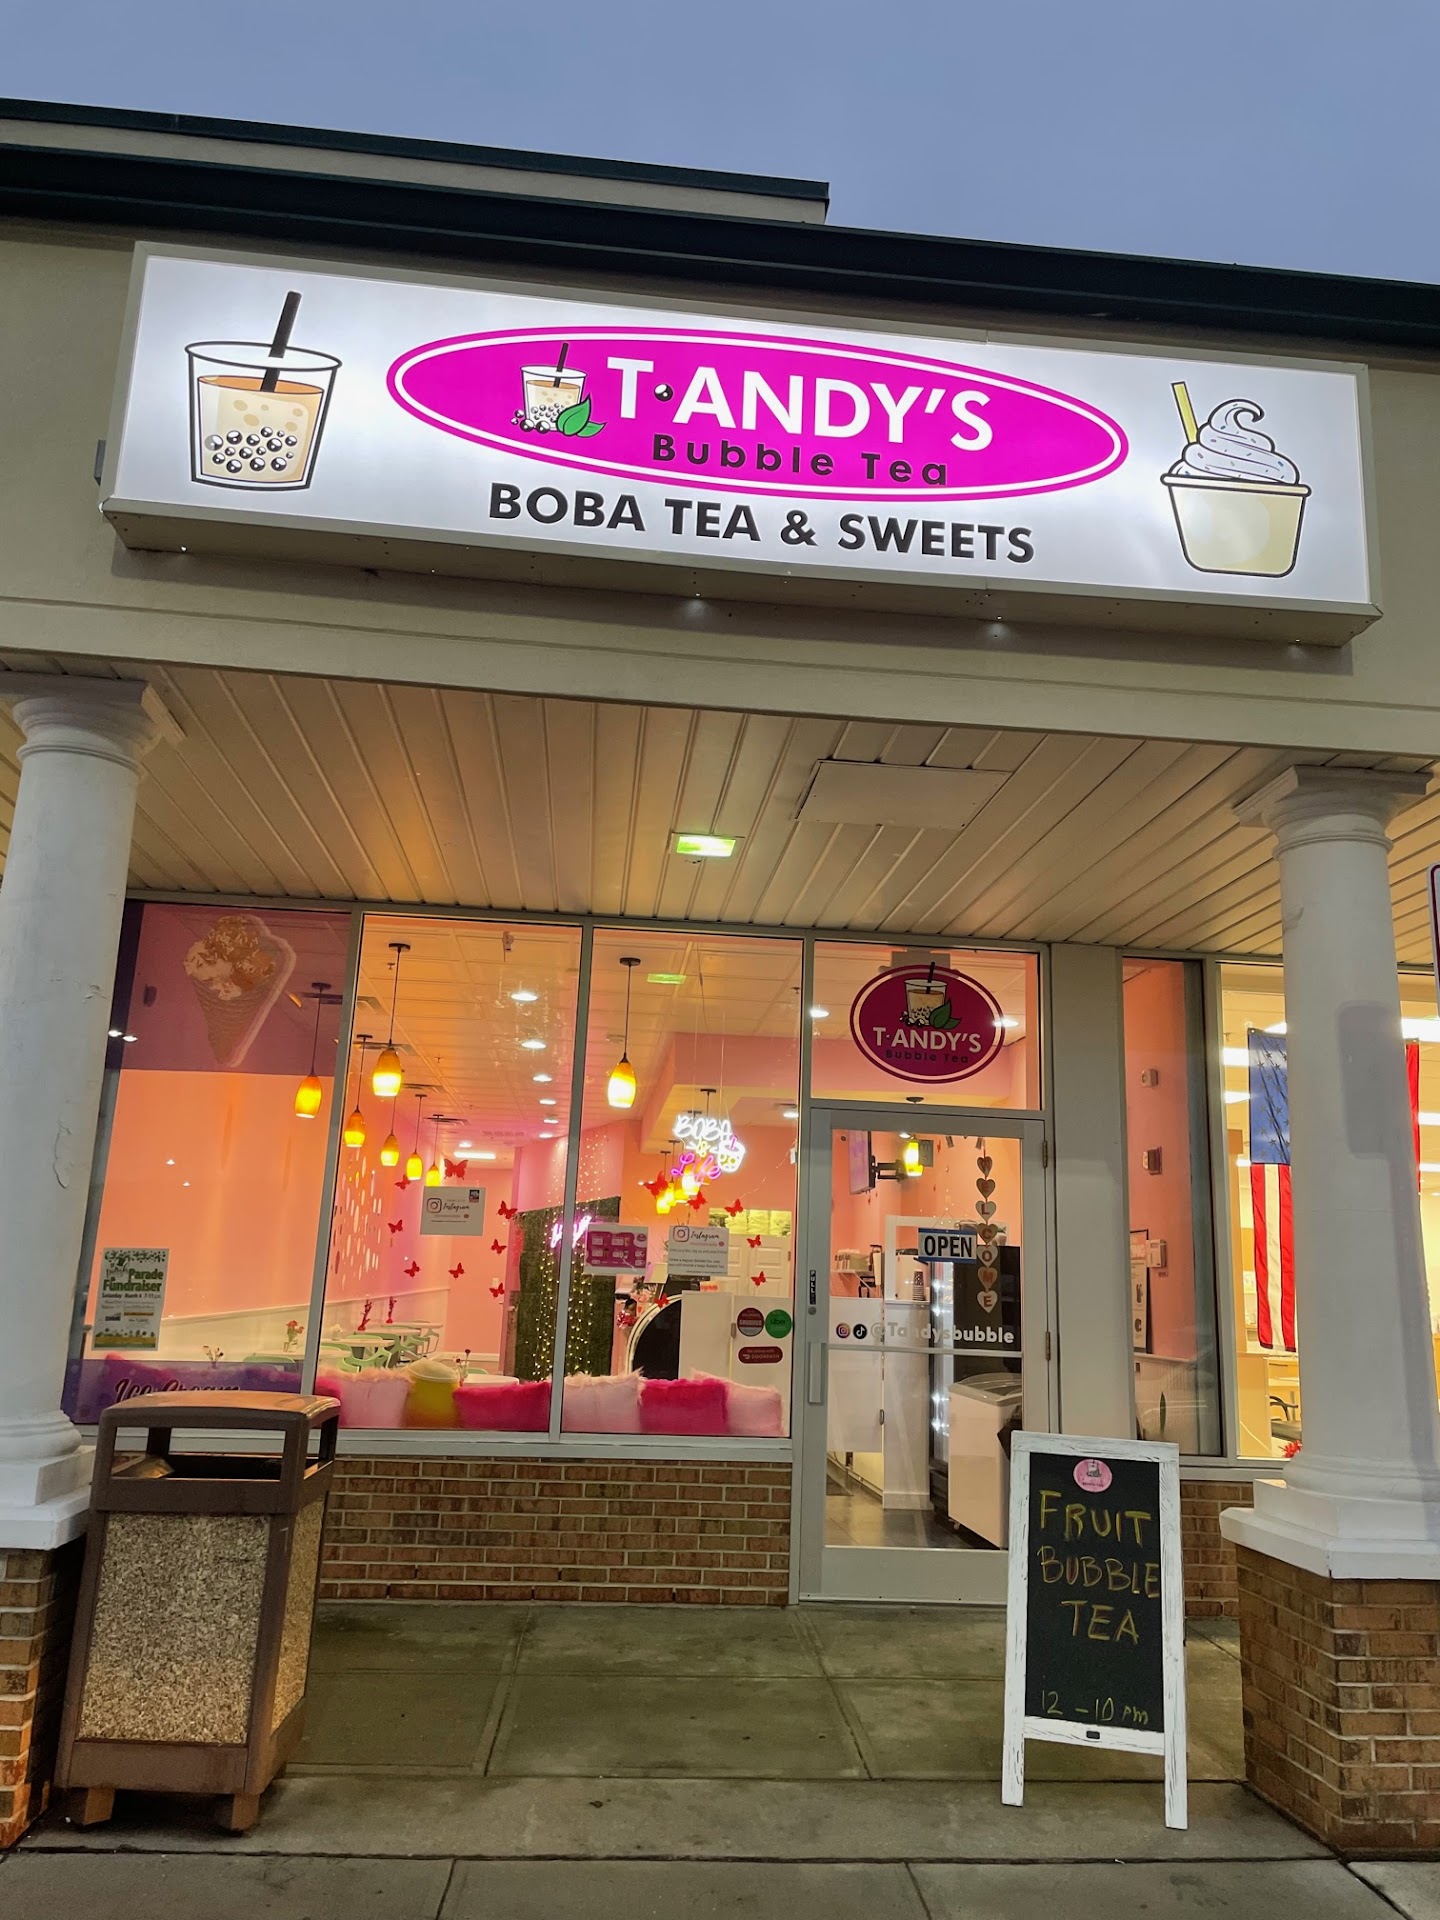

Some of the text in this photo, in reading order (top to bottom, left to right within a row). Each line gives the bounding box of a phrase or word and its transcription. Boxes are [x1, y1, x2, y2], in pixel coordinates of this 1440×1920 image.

[652, 434, 948, 486] Bubble Tea
[488, 482, 1035, 564] BOBA TEA & SWEETS
[886, 1050, 969, 1063] Bubble Tea
[924, 1235, 972, 1257] OPEN
[103, 1279, 162, 1292] Fundraiser
[129, 1268, 164, 1281] Parade
[871, 1322, 1015, 1344] @Tadysbubble
[1039, 1490, 1151, 1546] FRUIT
[1037, 1546, 1160, 1598] BUBBLE
[1060, 1600, 1138, 1645] TEA
[1122, 1705, 1149, 1725] pm
